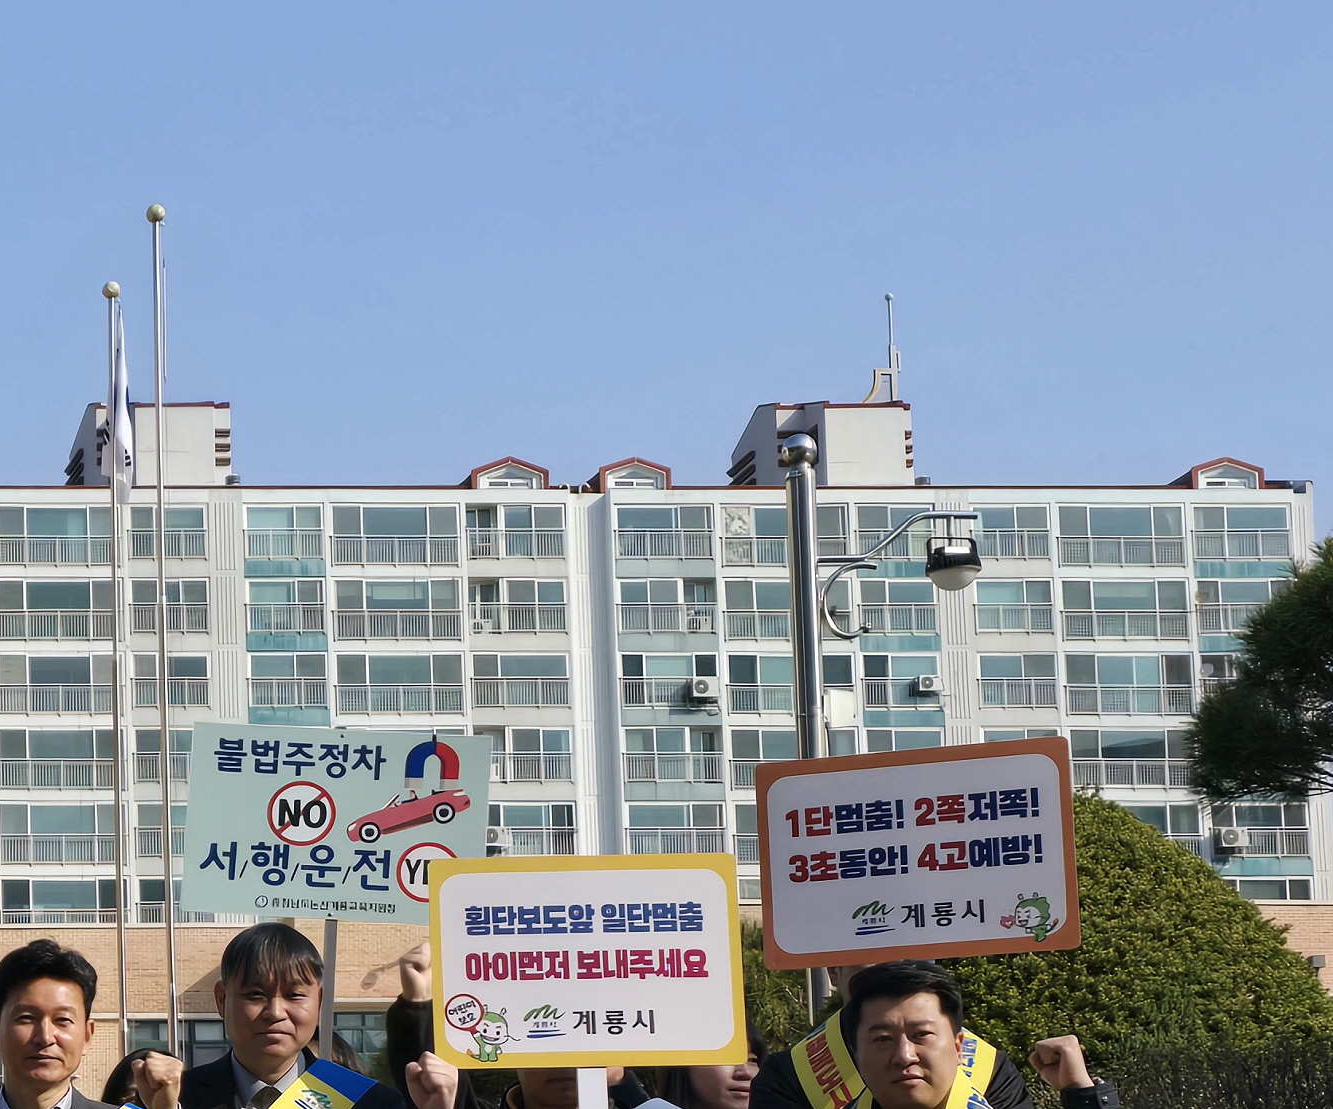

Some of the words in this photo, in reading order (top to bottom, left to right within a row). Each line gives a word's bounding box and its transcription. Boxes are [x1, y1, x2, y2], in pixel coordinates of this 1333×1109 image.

[213, 738, 387, 780] 불법주정차
[278, 798, 328, 829] NO
[785, 799, 905, 838] 1단멈춤!
[914, 787, 1040, 828] 2쪽저쪽!
[788, 844, 909, 884] 3초동안!
[917, 833, 1043, 872] 4고예방!
[464, 904, 595, 936] 횡단보도앞
[601, 902, 704, 933] 일단멈춤
[900, 899, 986, 928] 계룡시
[465, 951, 570, 981] 아이먼저
[577, 949, 709, 979] 보내주세요
[572, 1009, 656, 1035] 계룡시
